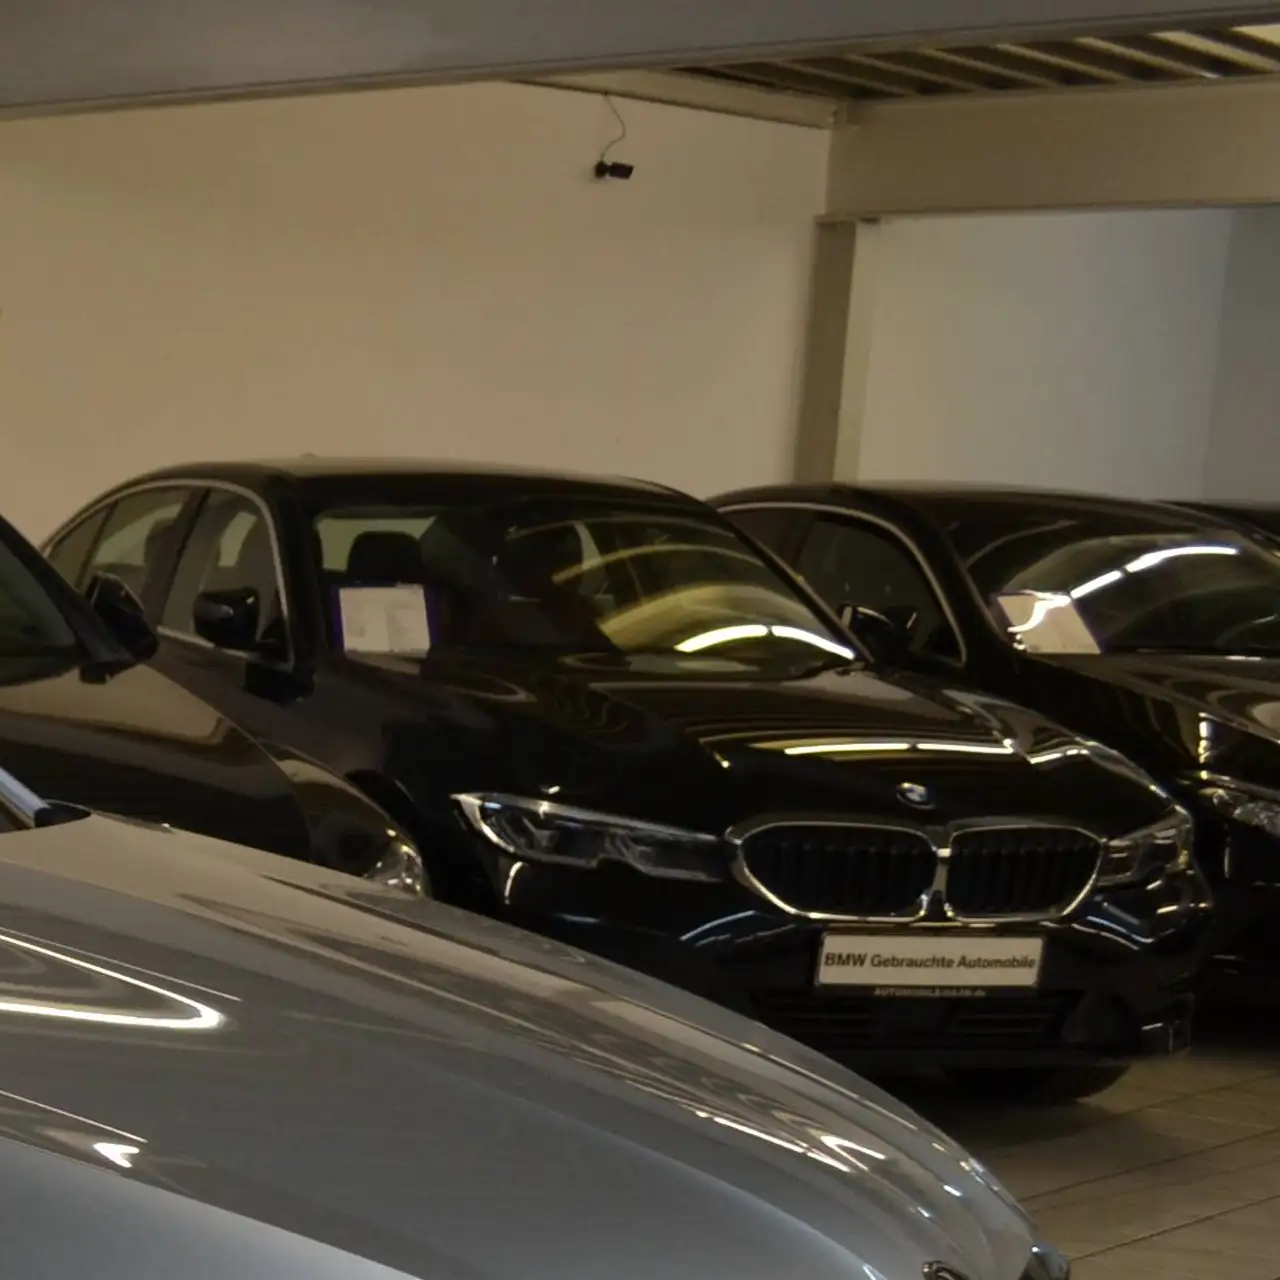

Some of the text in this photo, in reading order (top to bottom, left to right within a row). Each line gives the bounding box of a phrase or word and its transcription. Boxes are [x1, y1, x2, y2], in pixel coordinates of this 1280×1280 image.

[824, 952, 1036, 969] BMW Gebrauchte Automobile
